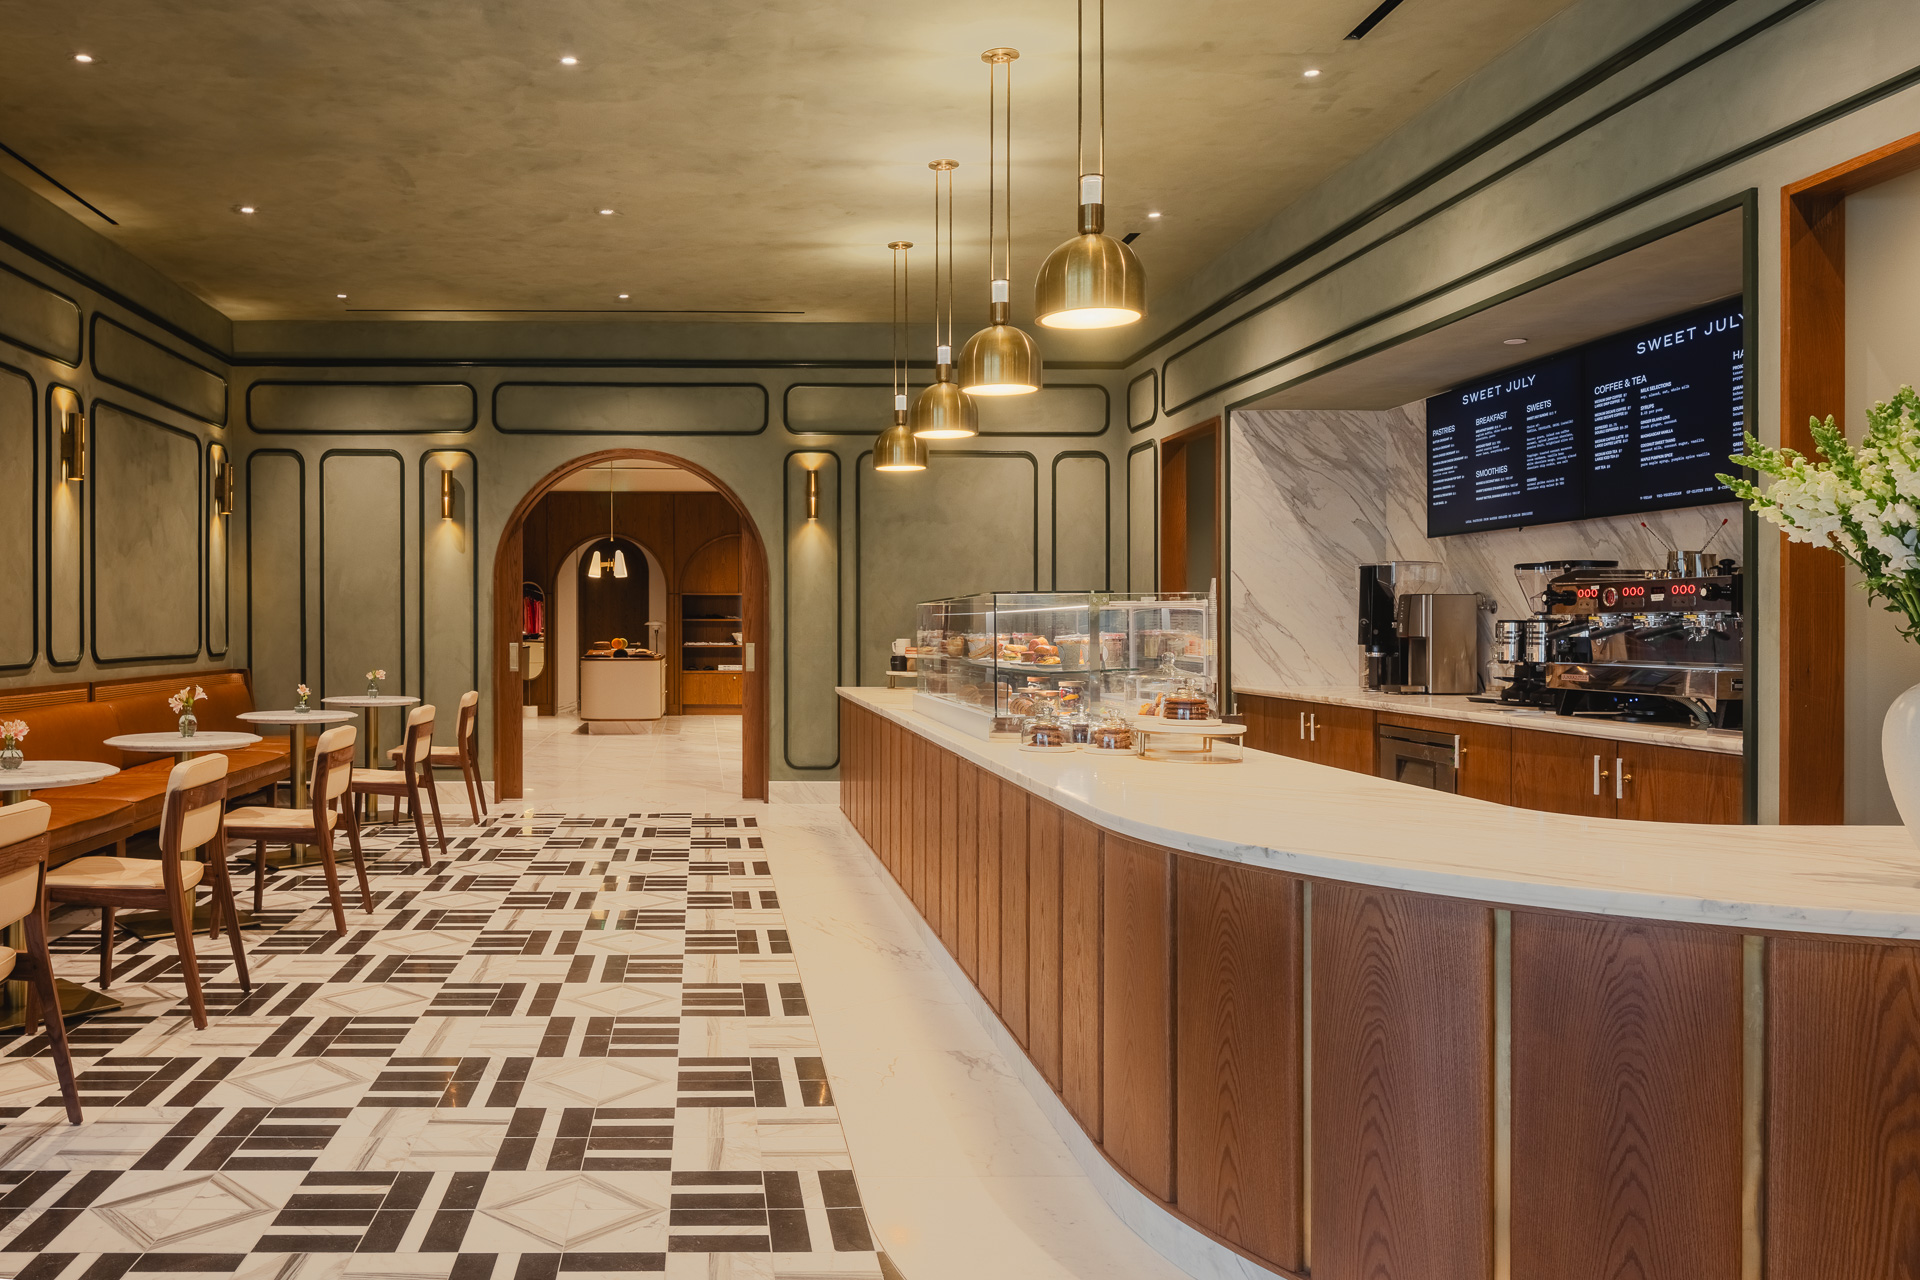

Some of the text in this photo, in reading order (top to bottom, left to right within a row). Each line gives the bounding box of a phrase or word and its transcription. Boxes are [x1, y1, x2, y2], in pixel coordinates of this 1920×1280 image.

[1636, 326, 1696, 354] SWEET
[1462, 374, 1536, 405] SWEET JULY
[1594, 375, 1647, 395] COFFEE & TEA
[1650, 381, 1671, 391] SELECTIONS
[1527, 400, 1551, 412] SWEETS
[1476, 411, 1507, 426] BREAKFAST
[1432, 425, 1455, 437] PASTRIES
[1476, 465, 1508, 478] SMOOTHIES
